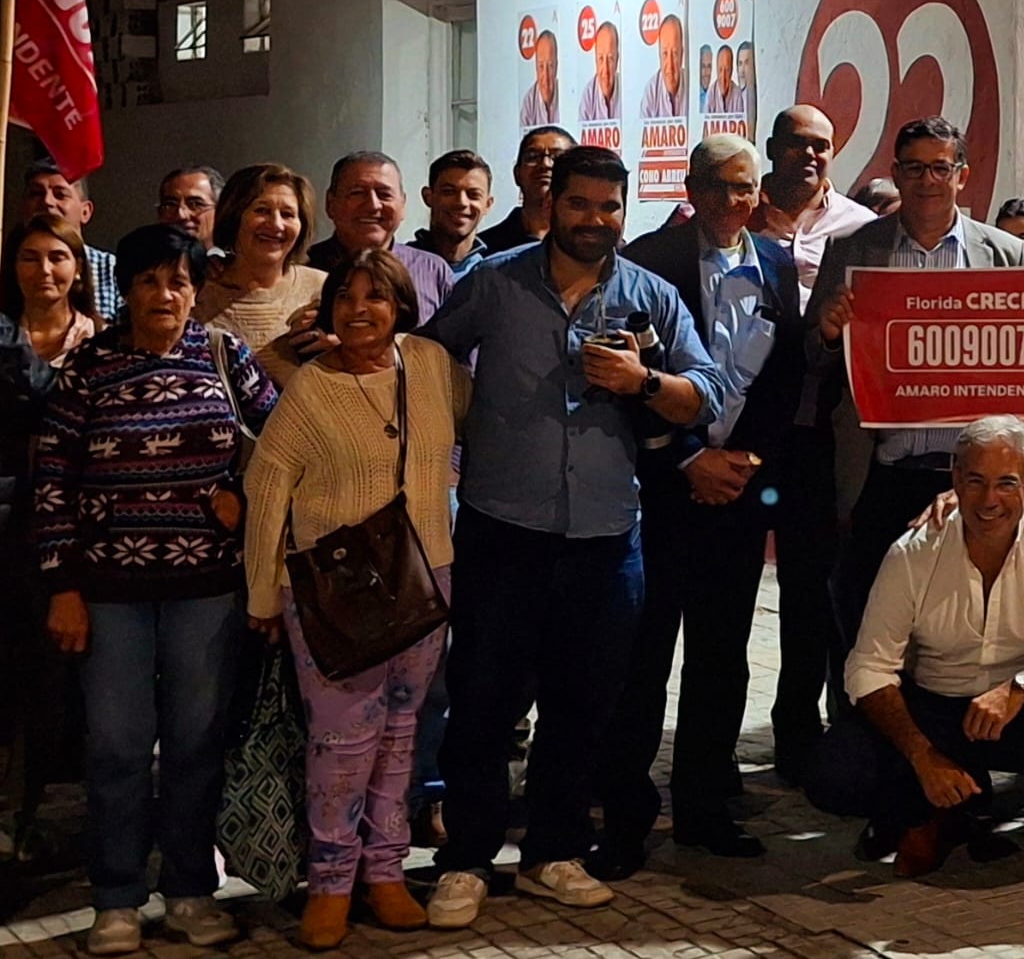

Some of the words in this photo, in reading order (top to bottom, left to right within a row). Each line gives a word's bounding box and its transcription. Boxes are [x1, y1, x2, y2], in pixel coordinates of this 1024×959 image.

[581, 18, 595, 40] 25
[642, 14, 659, 31] 222
[717, 14, 736, 28] 9007
[522, 27, 534, 49] 22
[581, 127, 620, 147] AMARO
[641, 125, 686, 148] AMARO
[906, 296, 963, 310] Florida
[895, 384, 950, 397] AMARO
